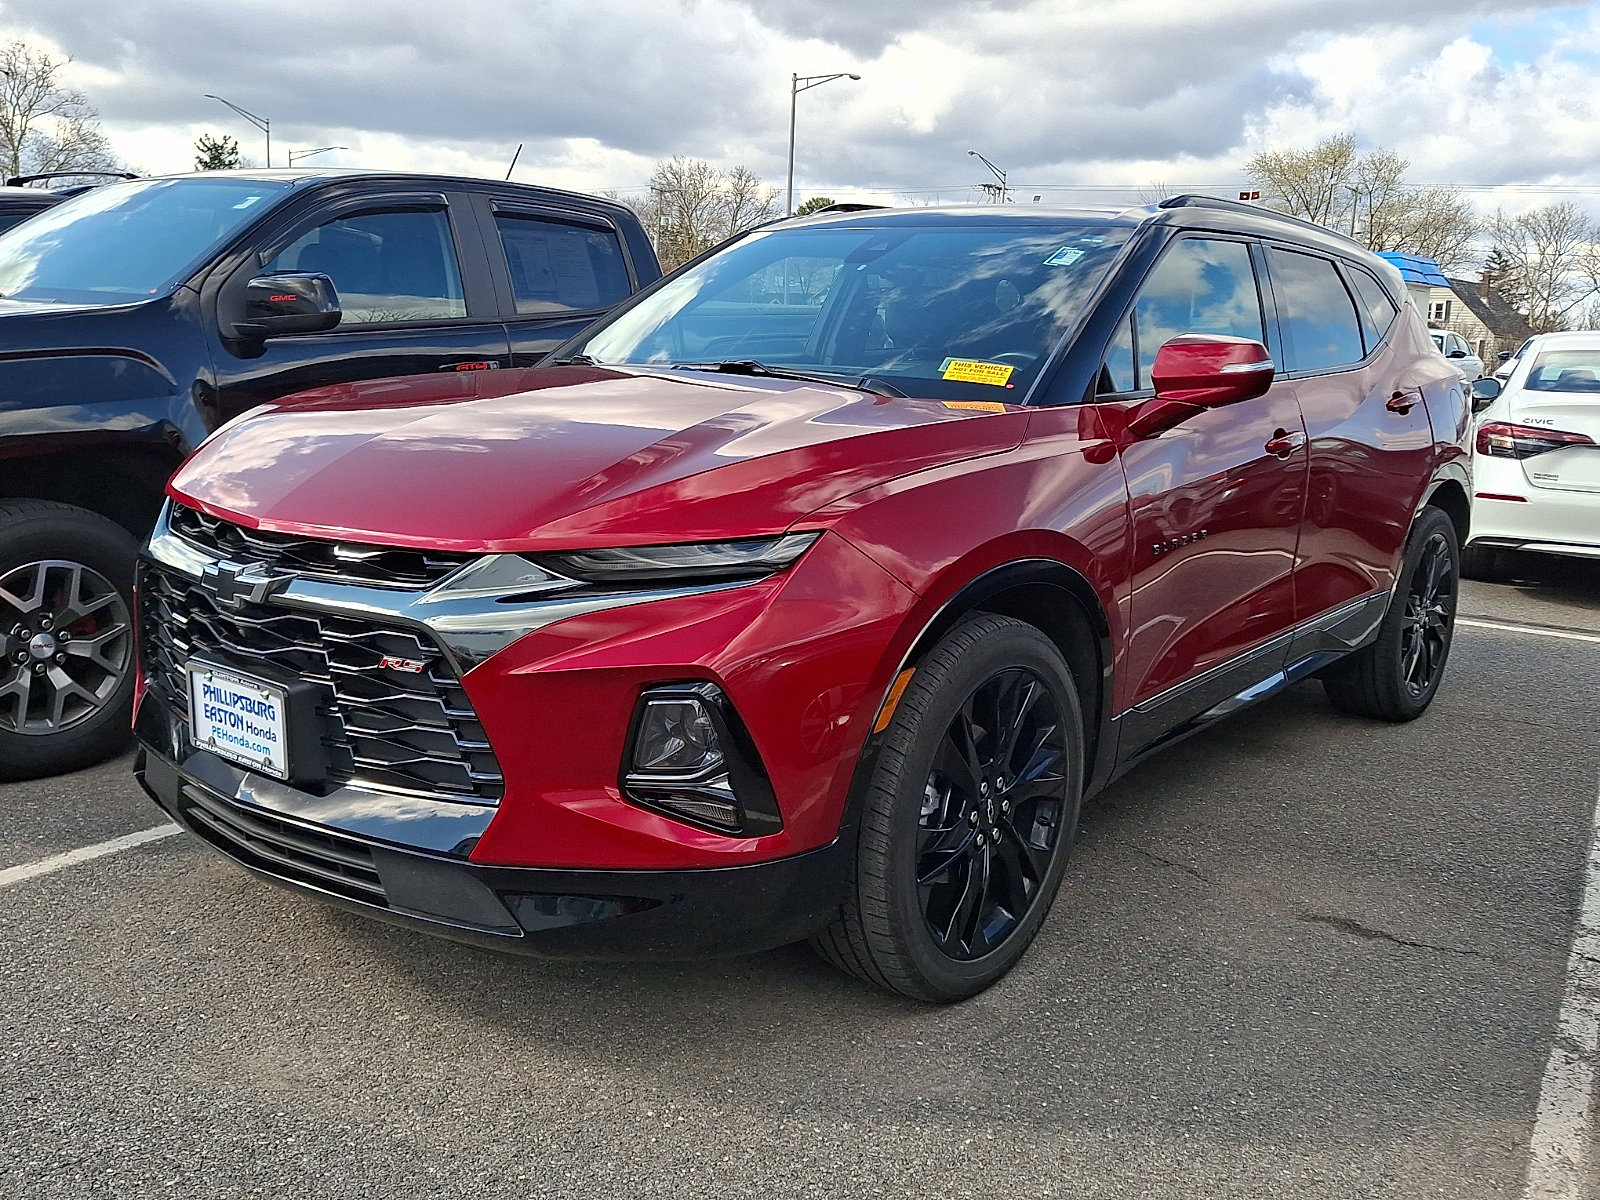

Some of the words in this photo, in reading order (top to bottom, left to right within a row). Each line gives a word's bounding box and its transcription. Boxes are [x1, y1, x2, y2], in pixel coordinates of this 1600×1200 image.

[269, 294, 297, 302] GMC
[953, 361, 972, 369] THIS
[974, 363, 1010, 373] VEHICLE
[1522, 417, 1555, 426] CIVIC
[1151, 528, 1208, 556] BLAZER
[379, 655, 425, 674] RS
[202, 683, 276, 721] PHILLIPSBURG
[204, 703, 244, 731] EASTON
[246, 720, 277, 742] Honda
[211, 725, 271, 756] PEHonda.com
